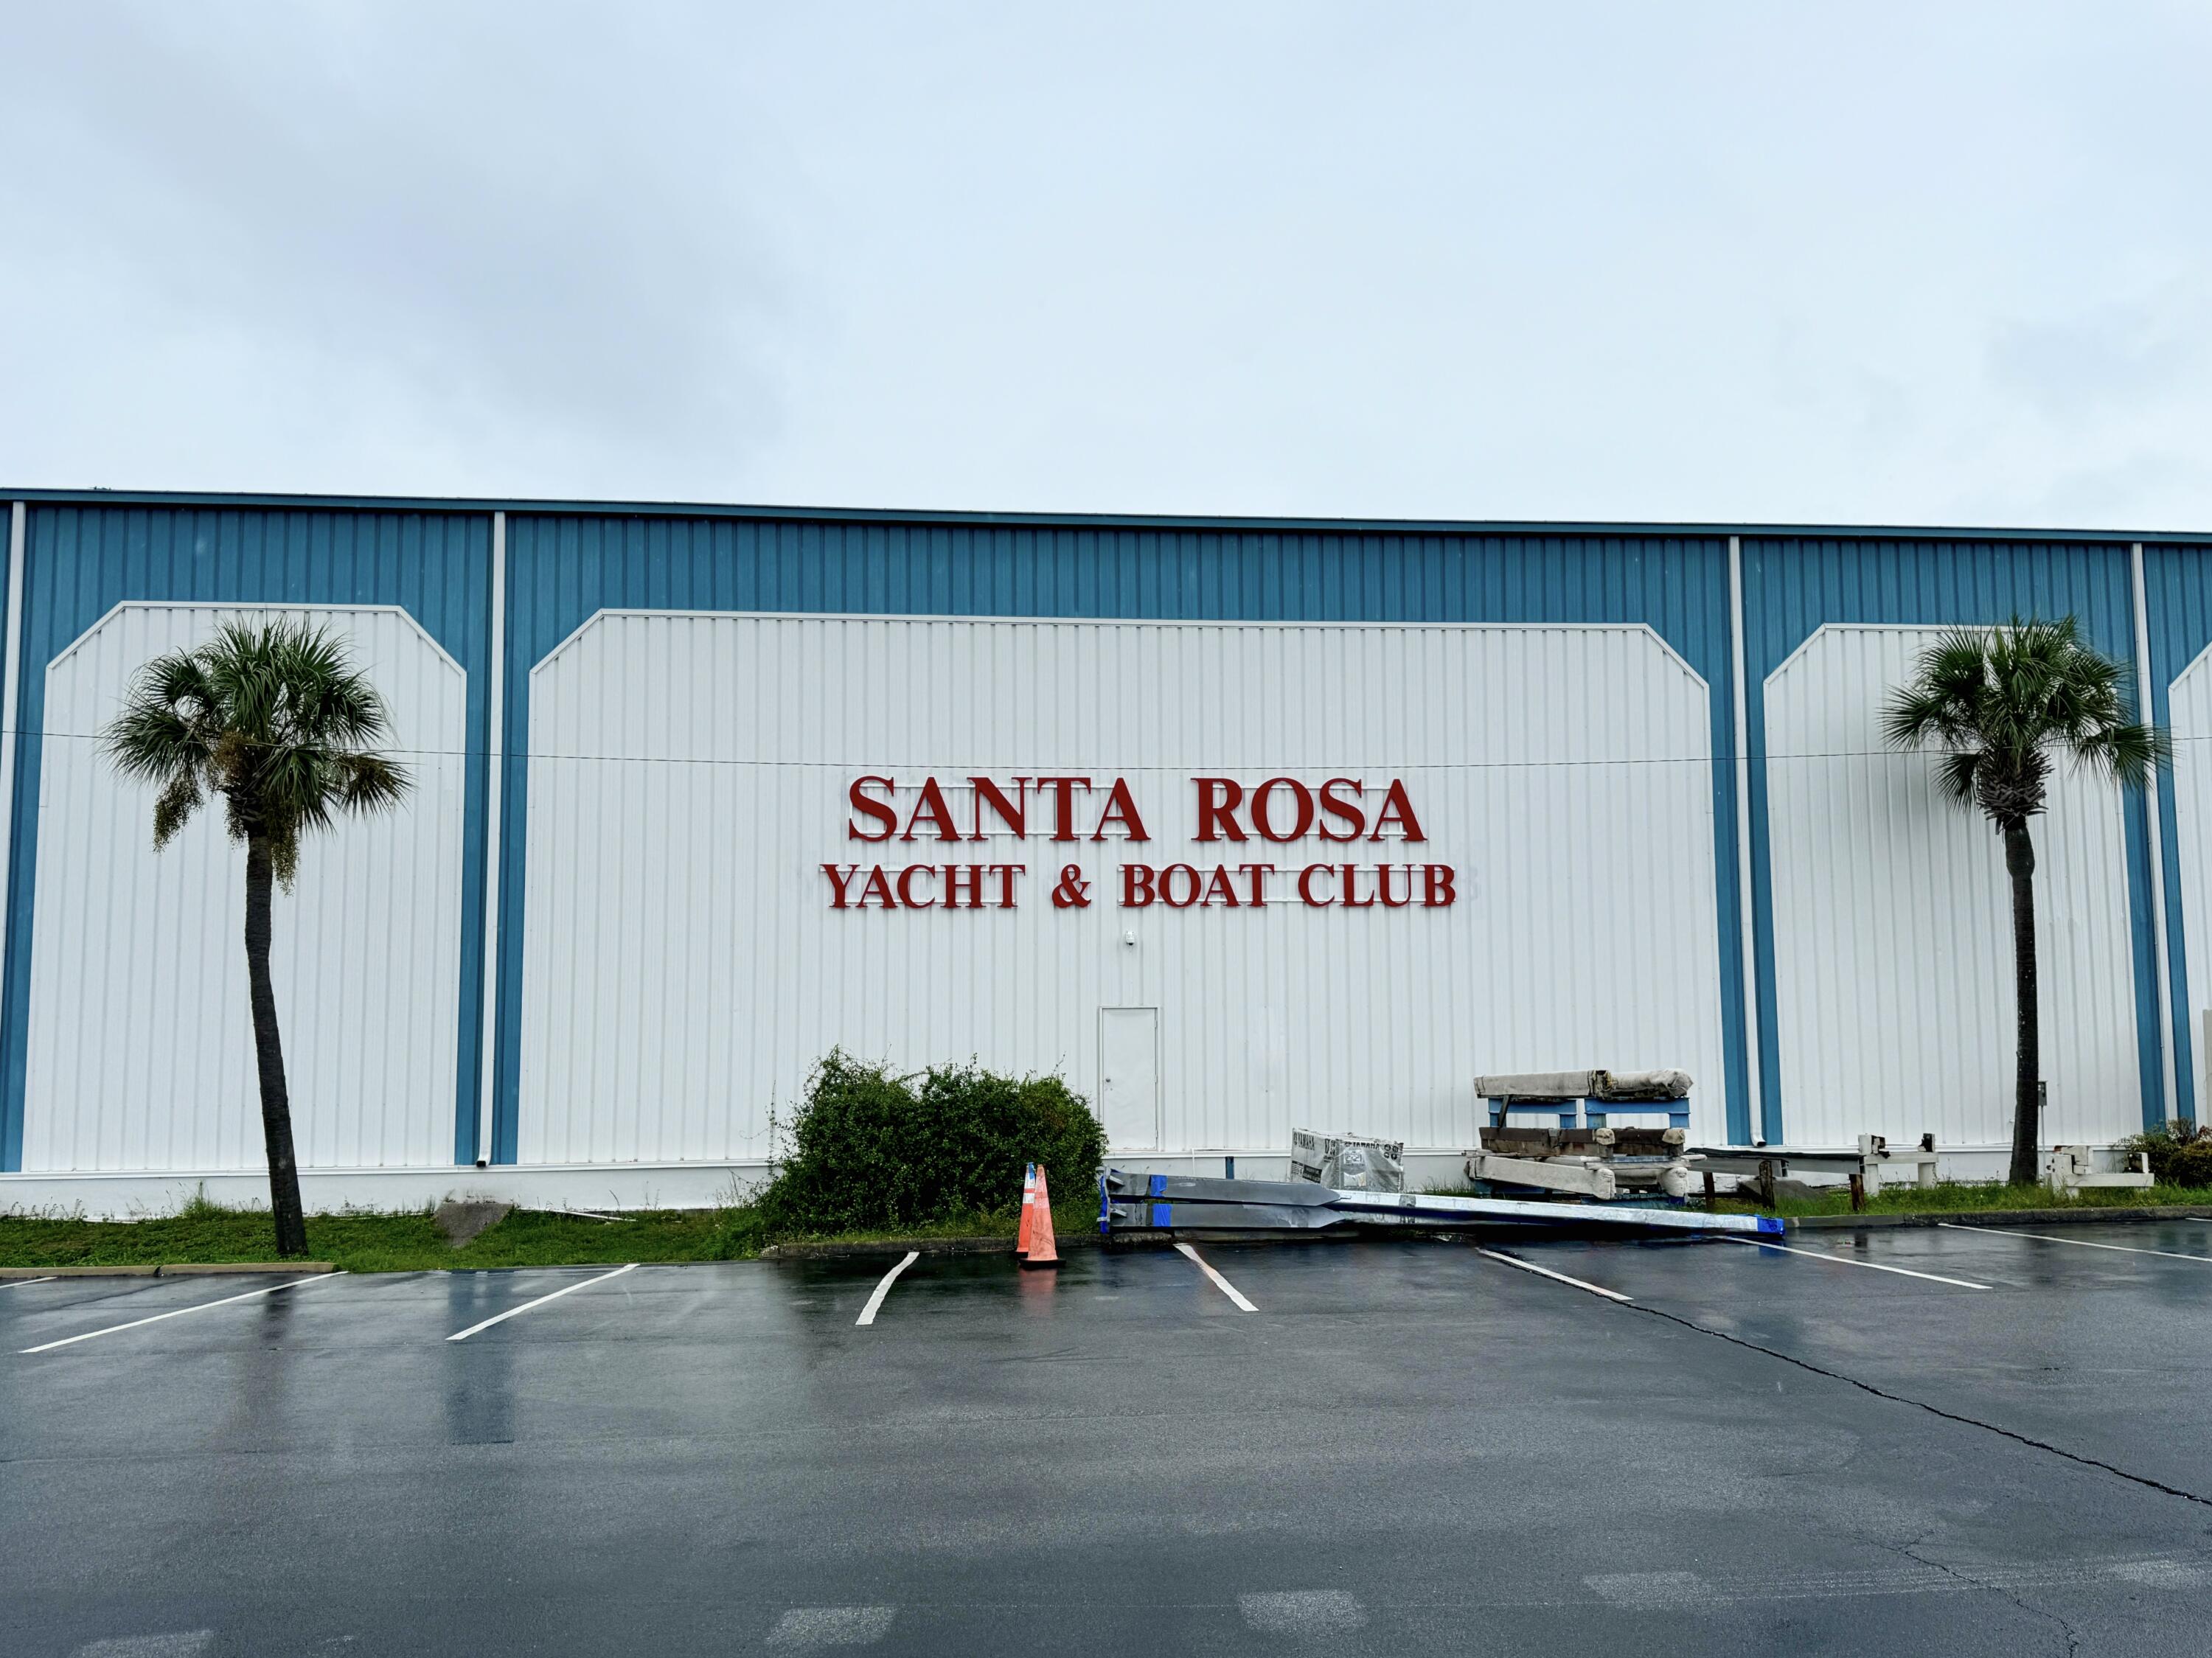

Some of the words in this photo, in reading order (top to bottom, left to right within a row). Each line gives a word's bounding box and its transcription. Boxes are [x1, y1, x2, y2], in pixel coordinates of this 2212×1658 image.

[849, 776, 1151, 842] SANTA
[1191, 778, 1427, 843] ROSA
[822, 864, 1026, 908] YACHT
[1051, 864, 1091, 908] &
[1120, 864, 1275, 908] BOAT
[1298, 864, 1456, 908] CLUB
[1353, 1141, 1380, 1150] YAMAHA
